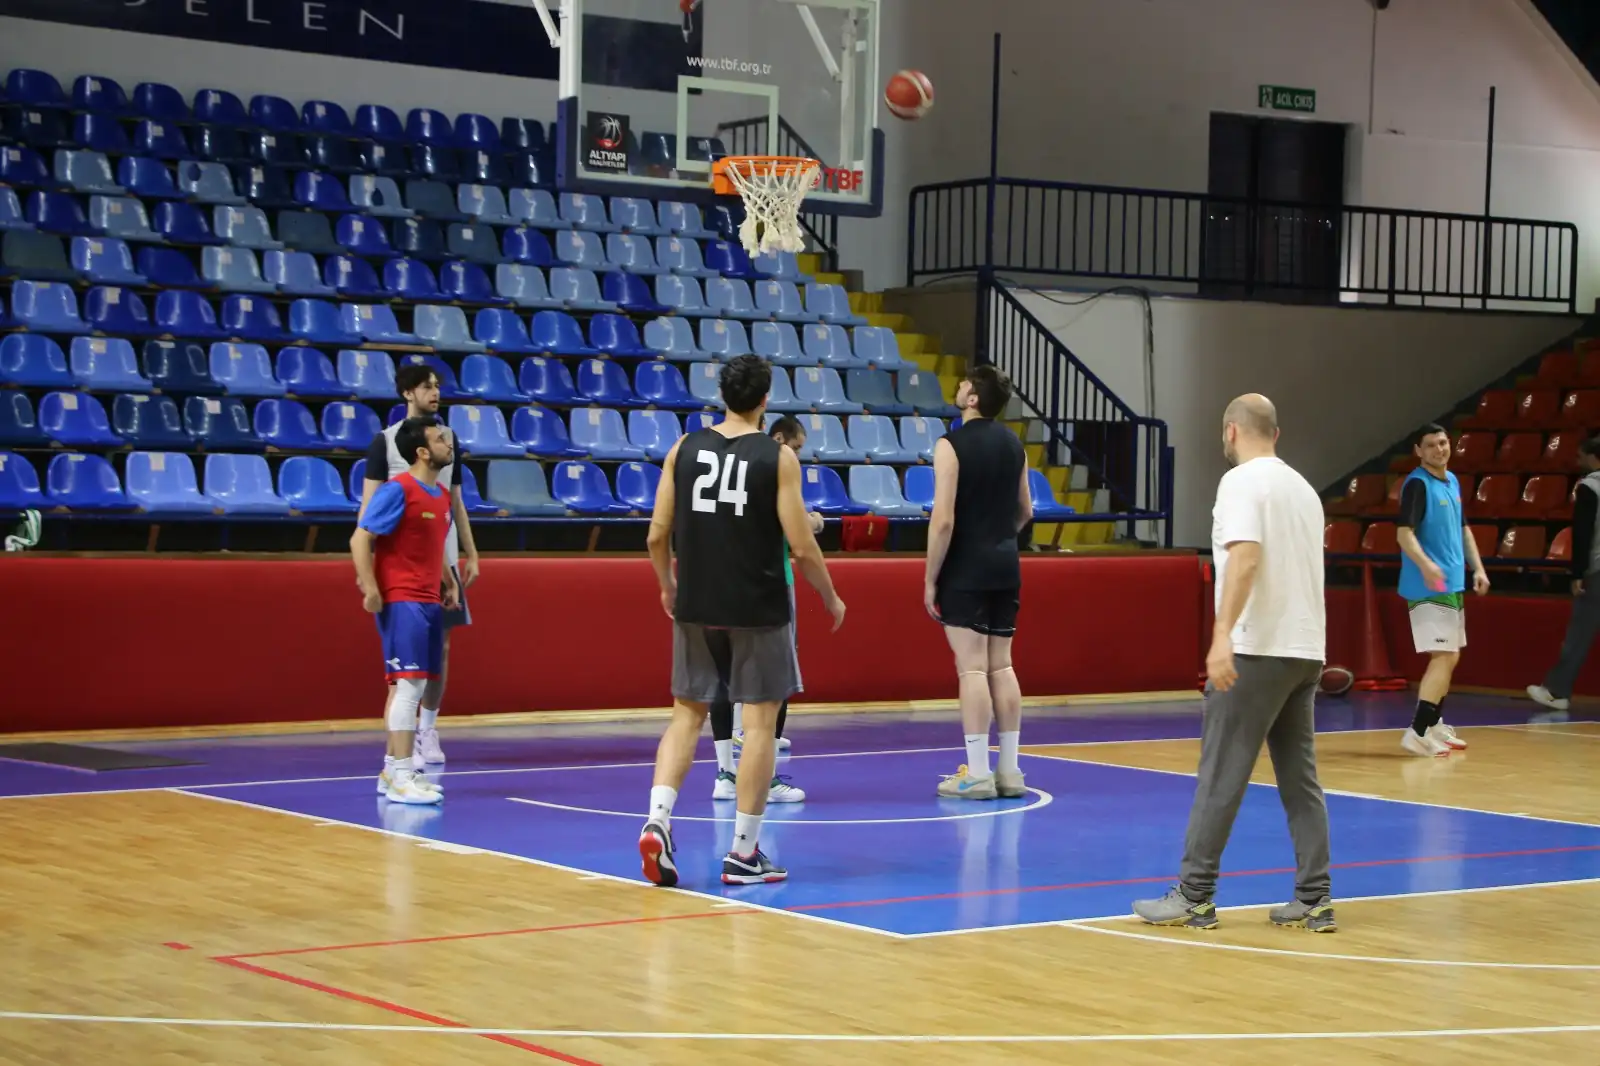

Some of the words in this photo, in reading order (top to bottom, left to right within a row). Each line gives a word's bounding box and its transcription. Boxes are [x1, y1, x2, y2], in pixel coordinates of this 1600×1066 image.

[124, 0, 404, 40] ELEN
[686, 56, 772, 76] www.tbf.org.tr
[589, 149, 627, 162] ALTYAPI
[823, 167, 864, 192] TBF
[691, 449, 749, 517] 24
